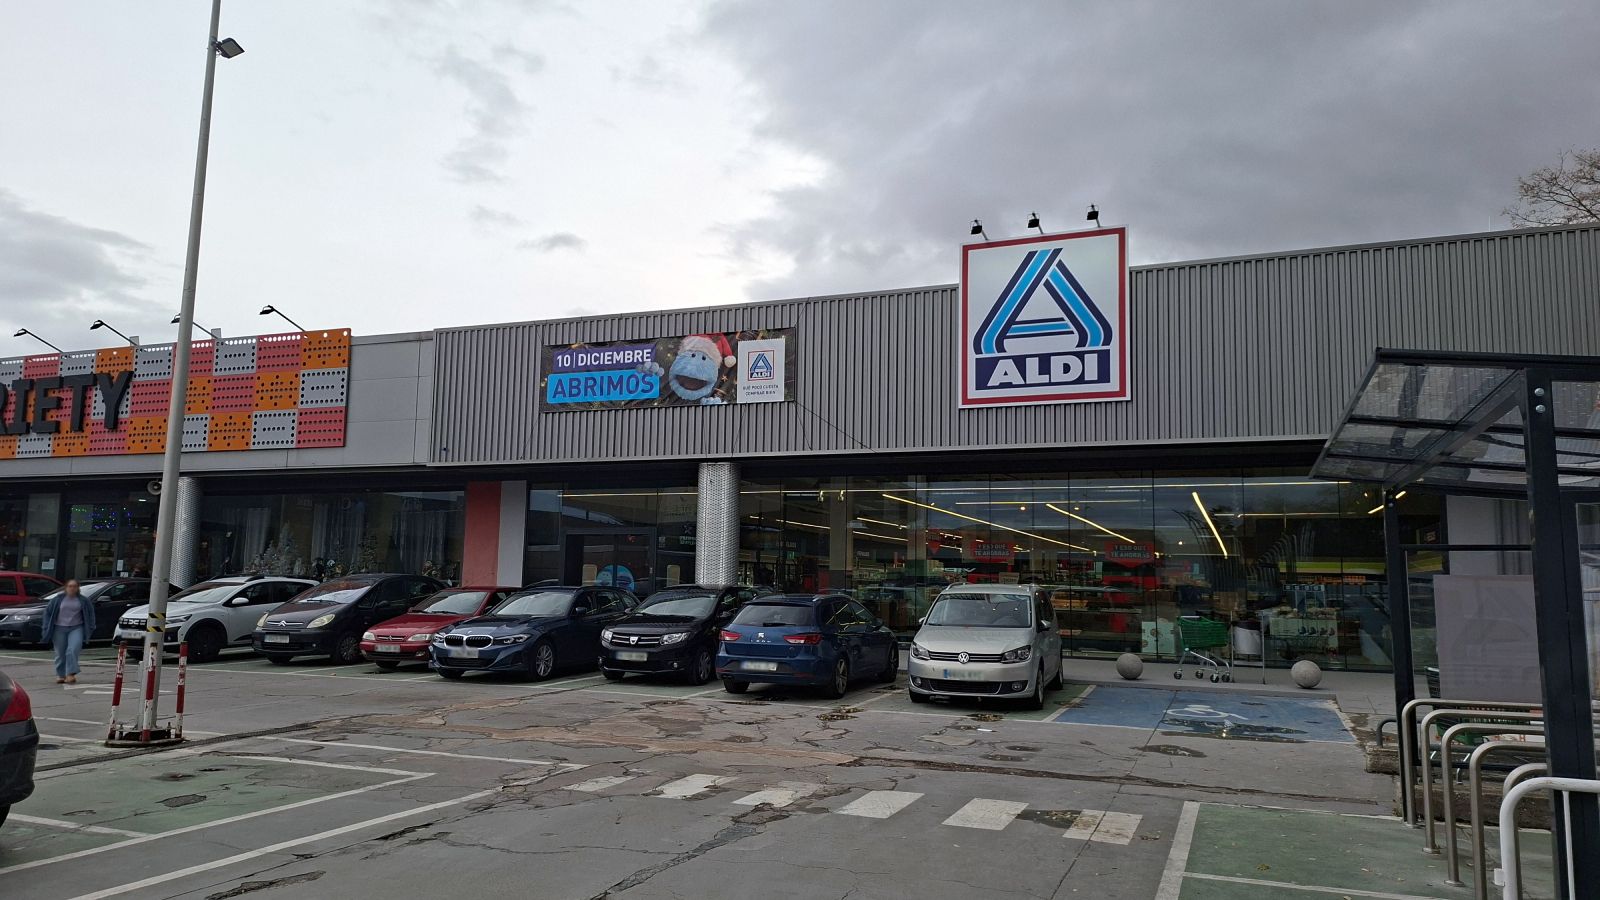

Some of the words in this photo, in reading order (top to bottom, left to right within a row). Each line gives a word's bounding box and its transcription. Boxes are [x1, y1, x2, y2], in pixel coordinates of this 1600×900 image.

[556, 354, 571, 368] 10
[577, 348, 652, 367] DICIEMBRE
[987, 353, 1097, 387] ALDI
[552, 373, 655, 399] ABRIMOS
[0, 370, 134, 435] IETY
